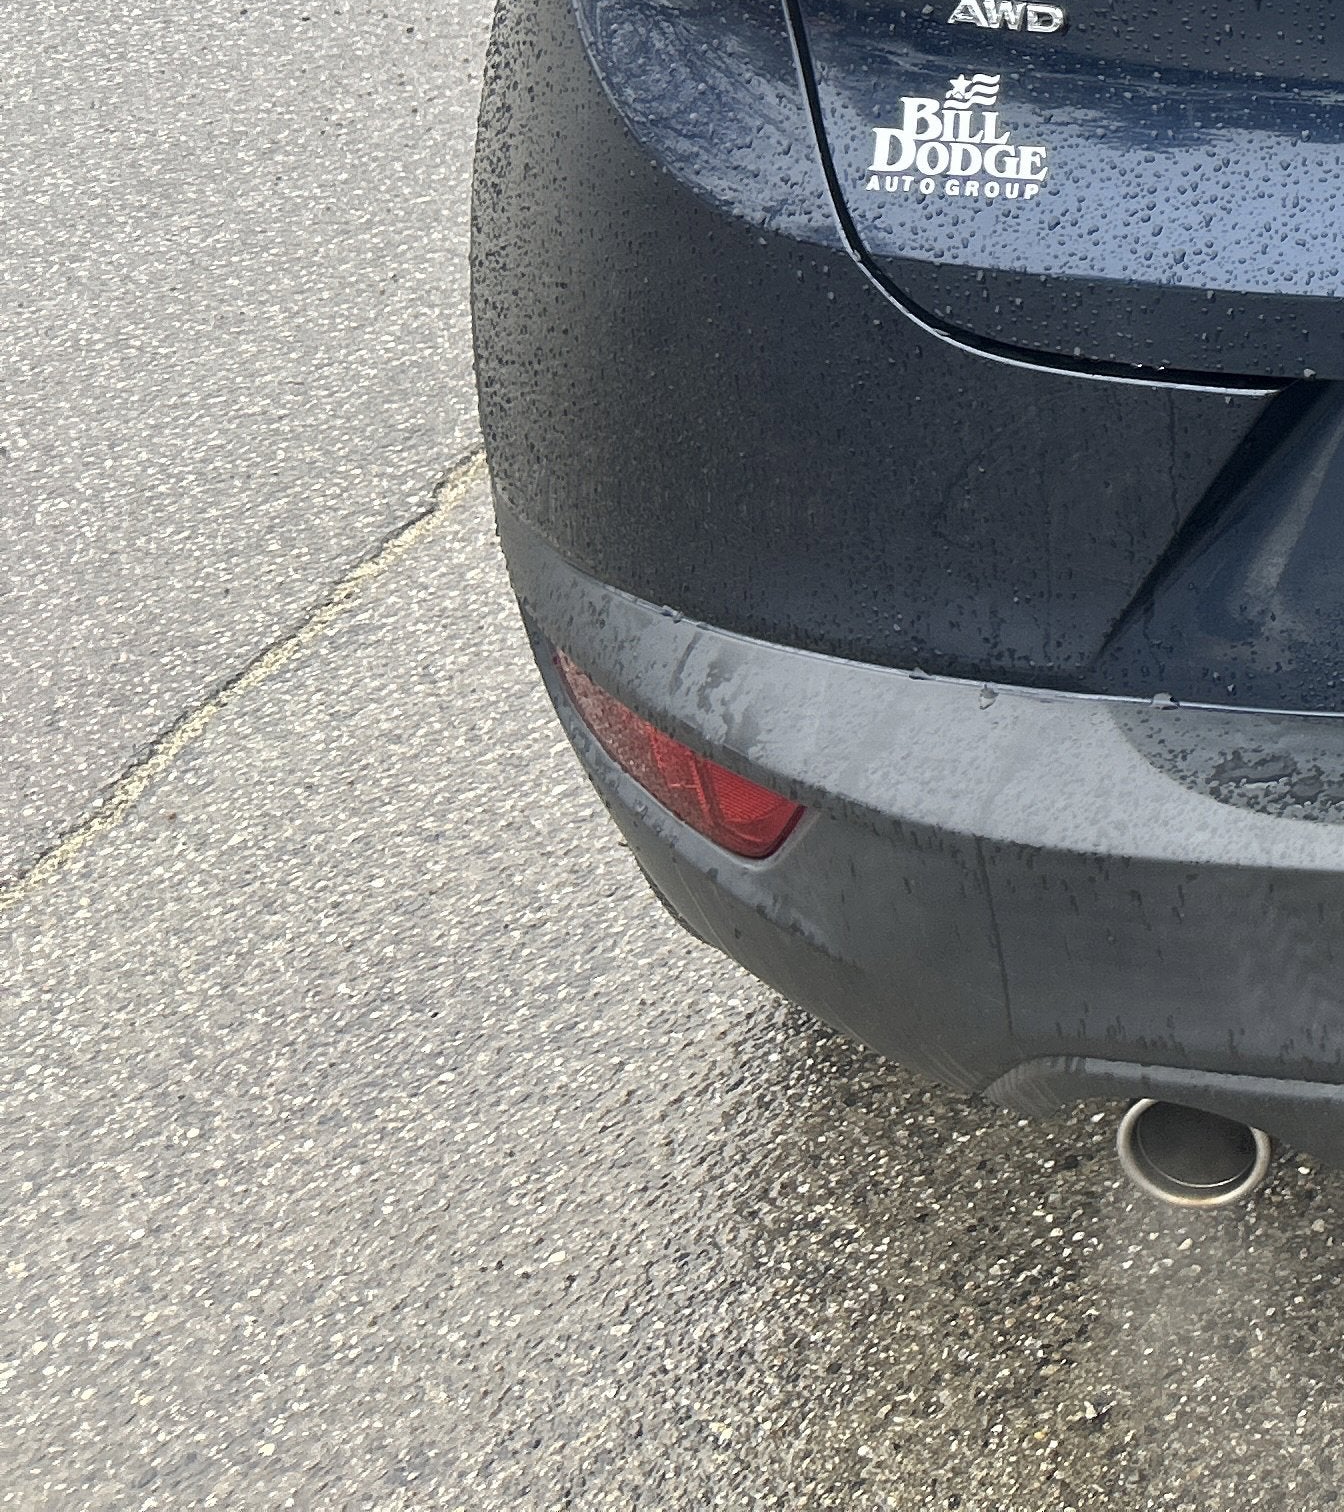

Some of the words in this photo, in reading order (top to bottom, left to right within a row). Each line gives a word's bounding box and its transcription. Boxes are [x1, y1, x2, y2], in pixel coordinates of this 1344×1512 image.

[899, 96, 1011, 144] BILL
[867, 127, 1048, 182] DODGE
[865, 175, 936, 196] AUTO
[944, 180, 1040, 200] GROUP
